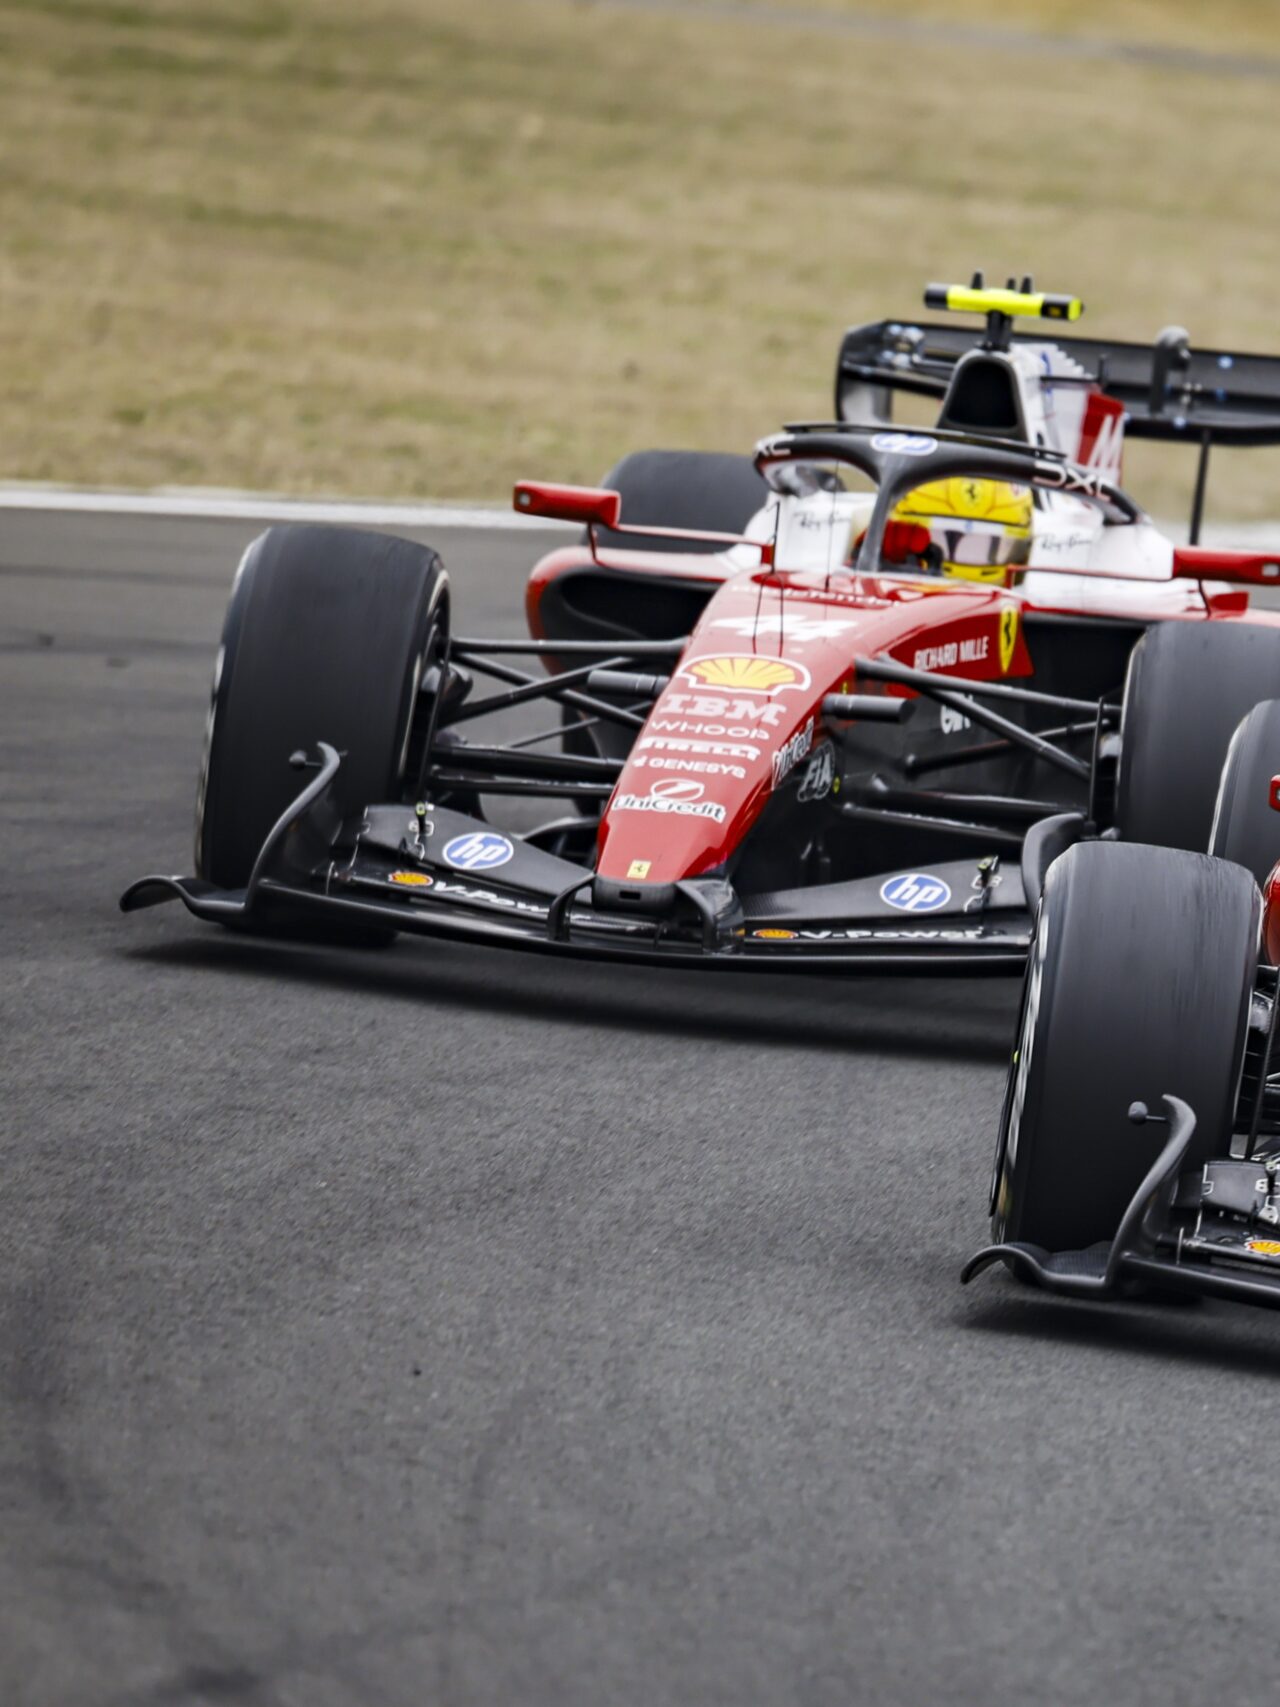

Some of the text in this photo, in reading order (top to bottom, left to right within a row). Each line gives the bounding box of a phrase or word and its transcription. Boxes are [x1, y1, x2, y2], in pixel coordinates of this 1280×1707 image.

[914, 635, 989, 671] RICHARD MILLE
[658, 693, 787, 726] IBM
[650, 719, 769, 740] WHOOP
[638, 736, 761, 761] PIRELLI
[649, 757, 746, 779] GENESYS
[612, 794, 726, 823] UniCredit
[450, 833, 508, 868] hp
[889, 874, 944, 912] hp
